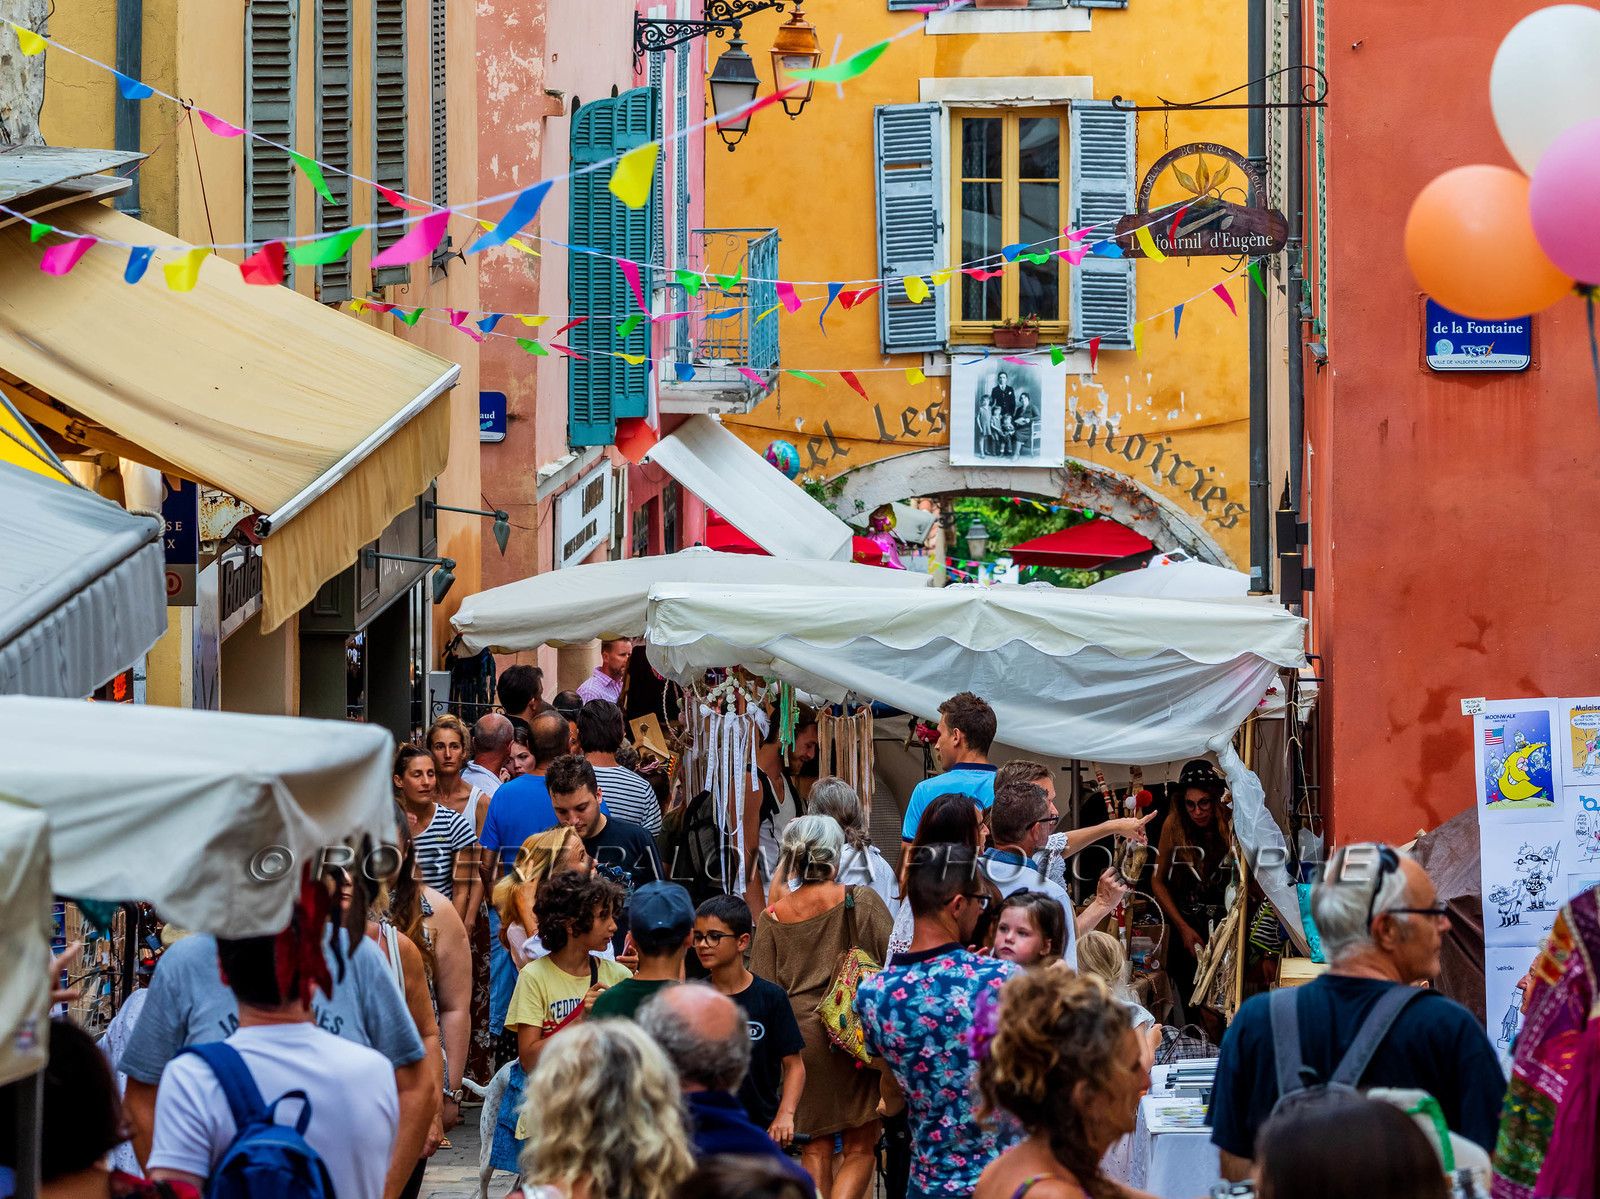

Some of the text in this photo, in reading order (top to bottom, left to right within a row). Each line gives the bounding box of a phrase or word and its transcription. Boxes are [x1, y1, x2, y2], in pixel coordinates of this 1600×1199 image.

[1156, 233, 1202, 250] fournil
[1210, 231, 1274, 253] d'Eugène
[1433, 321, 1523, 334] de la Fontaine
[1071, 411, 1249, 529] moiries
